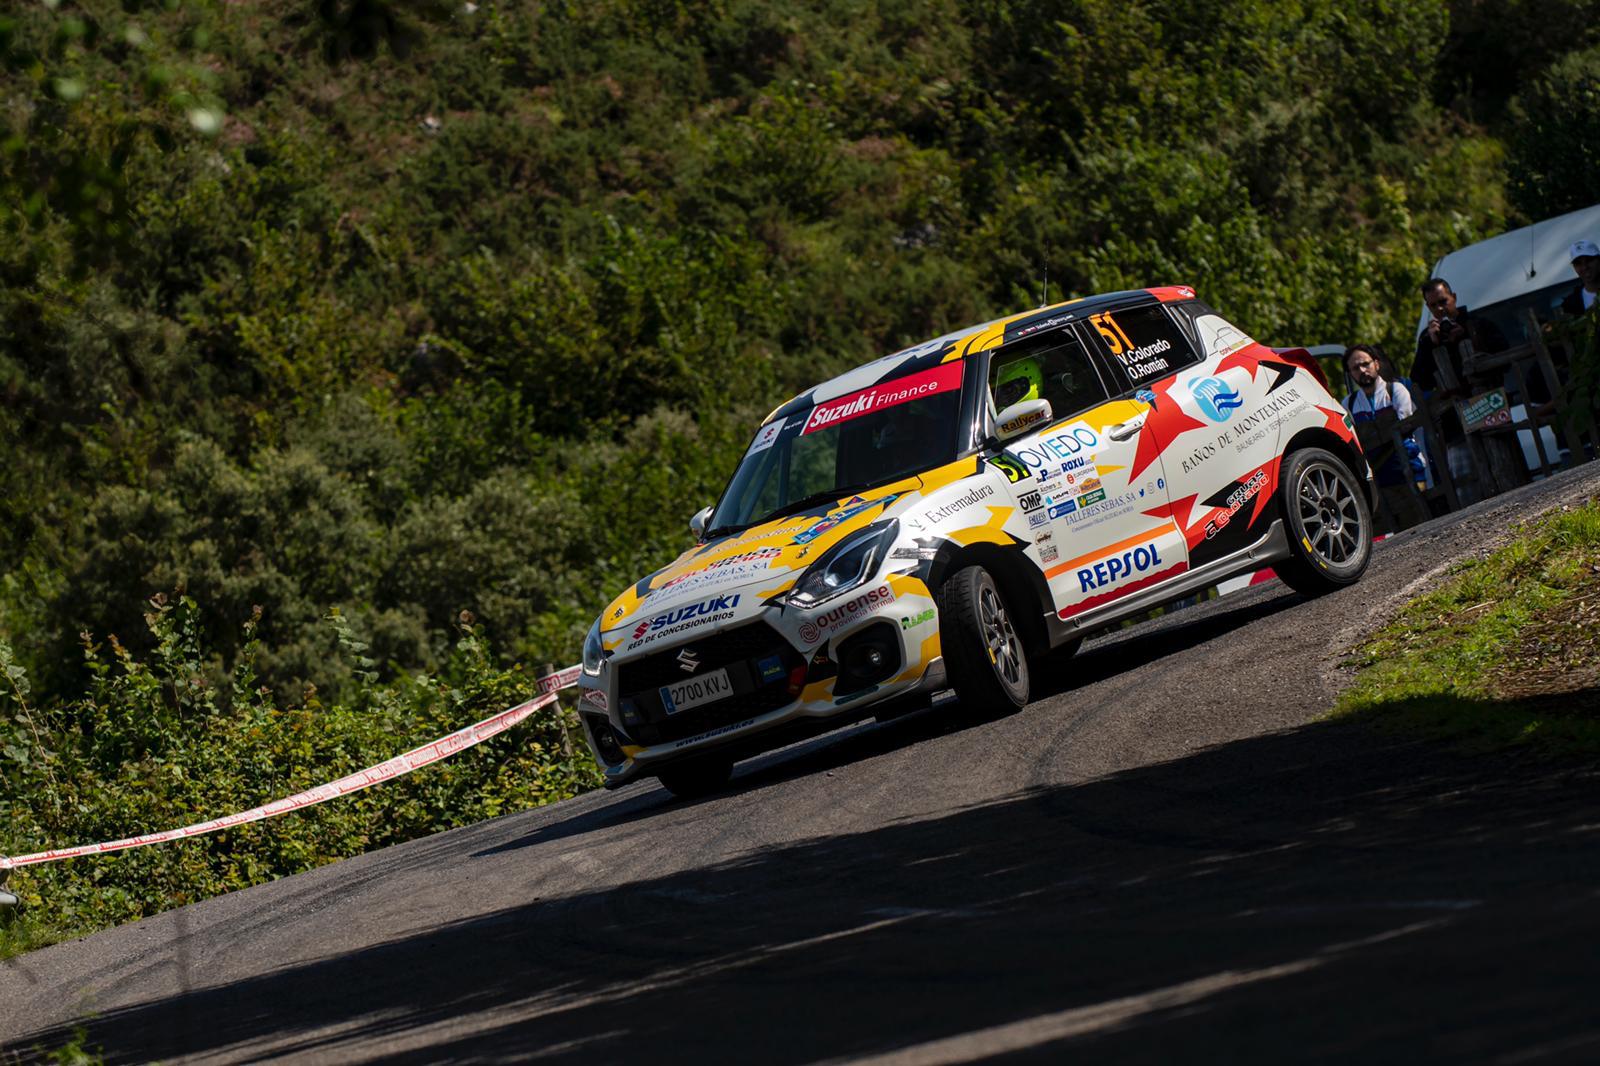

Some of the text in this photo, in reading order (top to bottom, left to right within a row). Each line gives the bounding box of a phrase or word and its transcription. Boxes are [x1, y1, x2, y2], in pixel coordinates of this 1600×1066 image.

[1088, 311, 1135, 355] 51
[1117, 338, 1171, 366] V.Colorado
[1127, 357, 1169, 379] O.Román
[810, 381, 938, 428] Suzuki Finance
[1001, 409, 1045, 432] Rallycar
[1217, 431, 1233, 449] DE
[1233, 388, 1301, 438] MONTEMAYOR
[1017, 428, 1097, 468] OVIEDO
[1061, 456, 1085, 473] ROXU
[925, 484, 994, 524] Extremadura
[1019, 493, 1042, 511] OMP
[1077, 543, 1162, 593] REPSOL
[651, 594, 741, 631] SUZUKI
[816, 585, 890, 628] ourense
[830, 595, 896, 632] provincia termal
[627, 611, 735, 651] RED DE CONCESIONARIOS
[671, 674, 730, 706] 2700 KVJ
